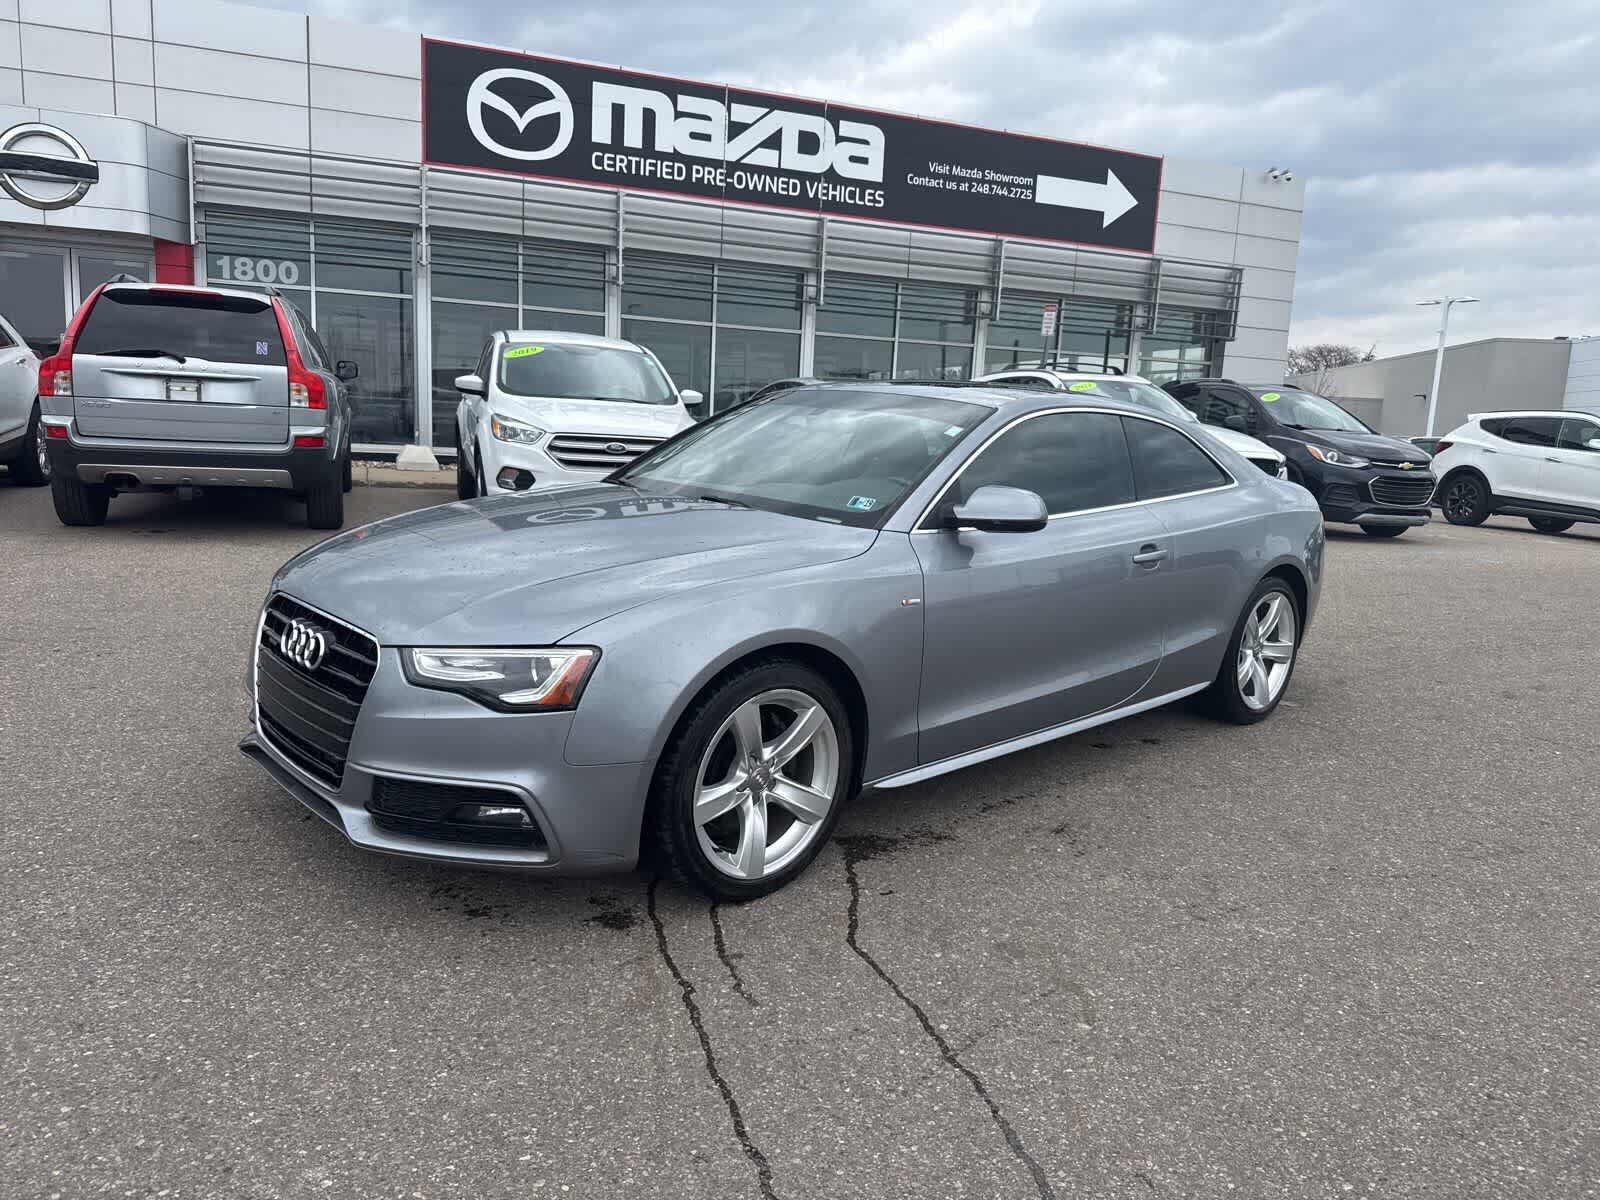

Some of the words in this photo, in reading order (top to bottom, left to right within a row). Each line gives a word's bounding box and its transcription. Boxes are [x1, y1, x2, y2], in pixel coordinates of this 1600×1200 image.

[592, 152, 687, 181] CERTIFIED
[692, 165, 801, 197] PRE-OWNED
[805, 180, 885, 208] VEHICLES
[907, 173, 943, 189] Contact
[945, 180, 958, 190] us
[959, 181, 970, 192] at
[971, 182, 1033, 200] 248.744.2725
[929, 161, 950, 175] Visit
[952, 164, 983, 179] Mazda
[984, 169, 1034, 187] Showroom
[216, 255, 299, 285] 1800
